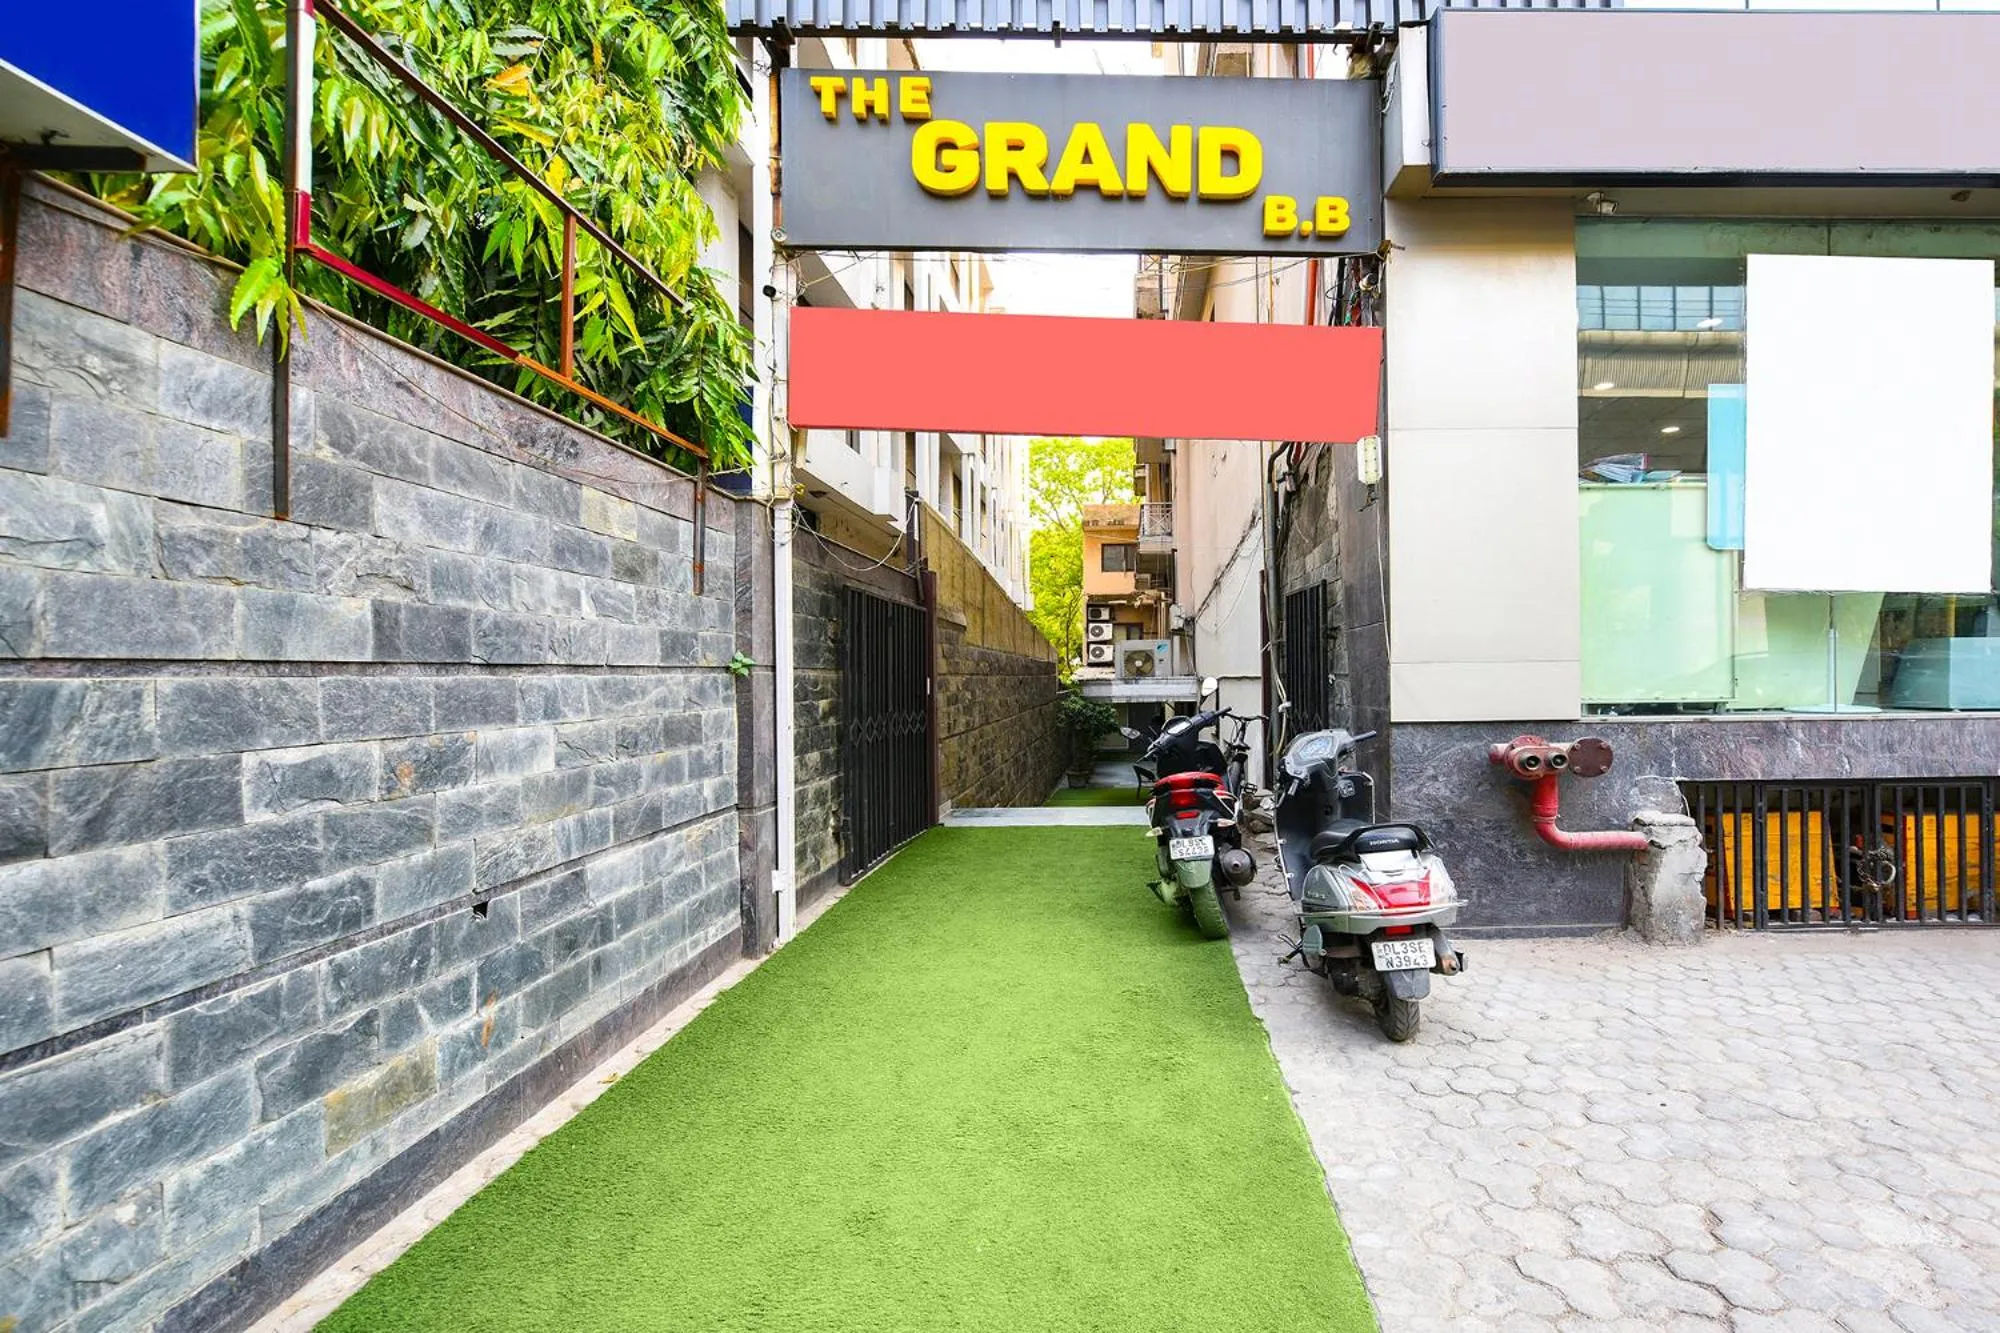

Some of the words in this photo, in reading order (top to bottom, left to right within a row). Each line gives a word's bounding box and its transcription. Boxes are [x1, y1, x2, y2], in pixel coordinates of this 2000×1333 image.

[810, 76, 932, 120] THE
[911, 119, 1263, 200] GRAND
[1263, 195, 1350, 237] B.B
